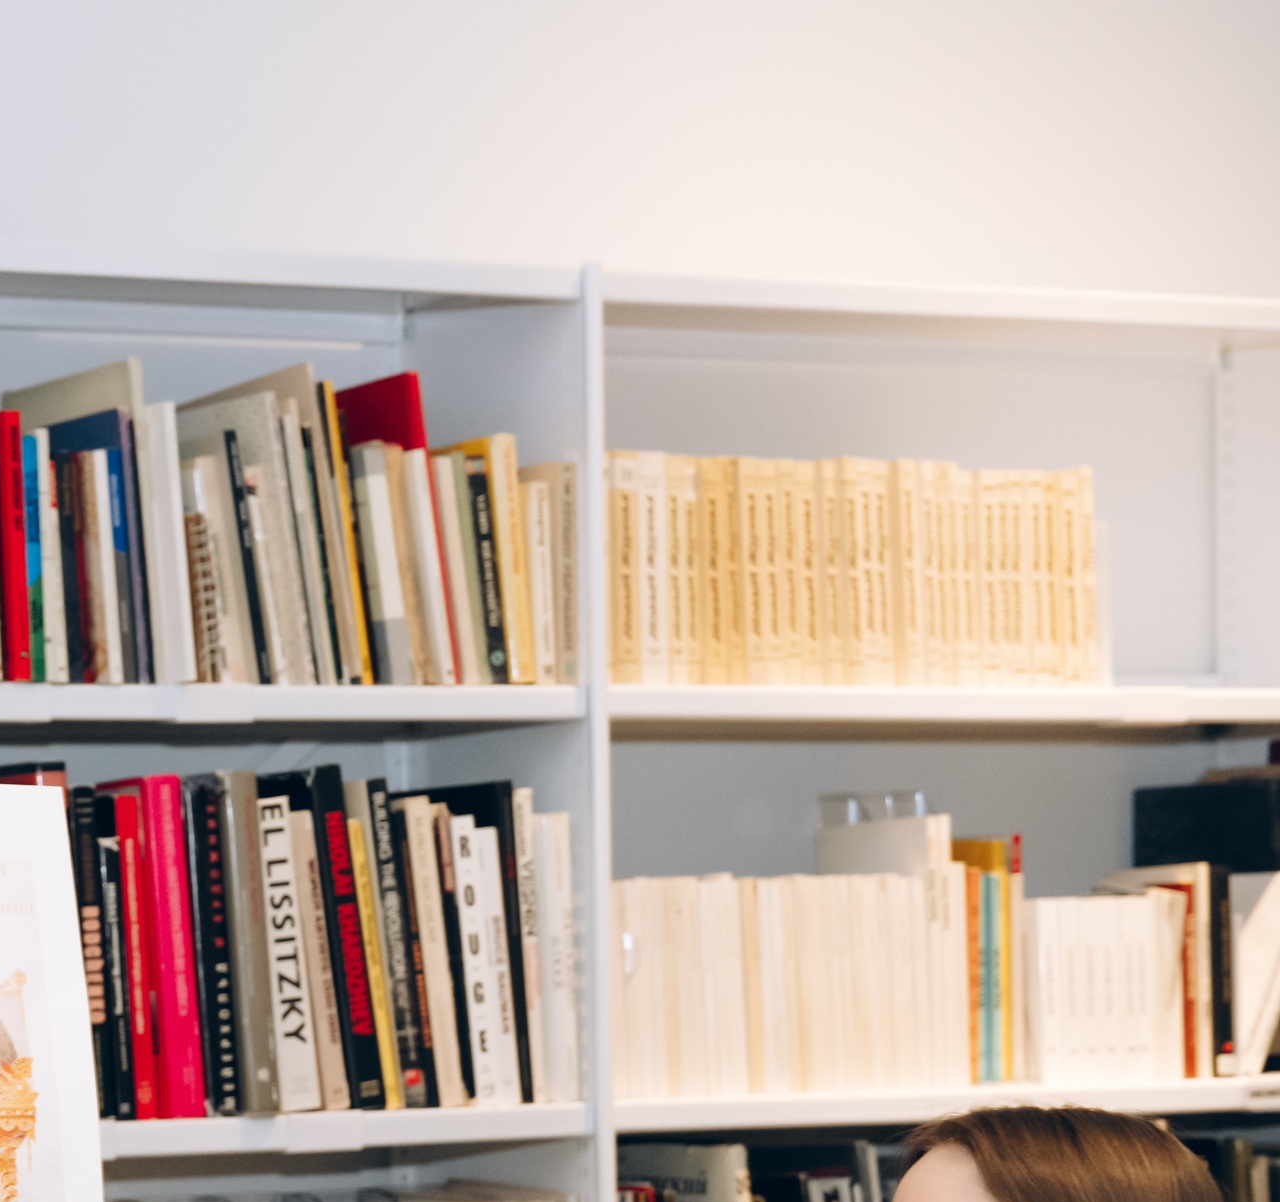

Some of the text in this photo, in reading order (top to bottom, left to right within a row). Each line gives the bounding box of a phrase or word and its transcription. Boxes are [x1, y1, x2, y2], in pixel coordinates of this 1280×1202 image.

[371, 790, 393, 859] BUILDING
[380, 863, 396, 888] THE
[261, 803, 307, 1044] EL LISSITZKY
[323, 810, 372, 1037] NIKOLAI KHARDZHIEV
[383, 889, 408, 979] REVOLUTION
